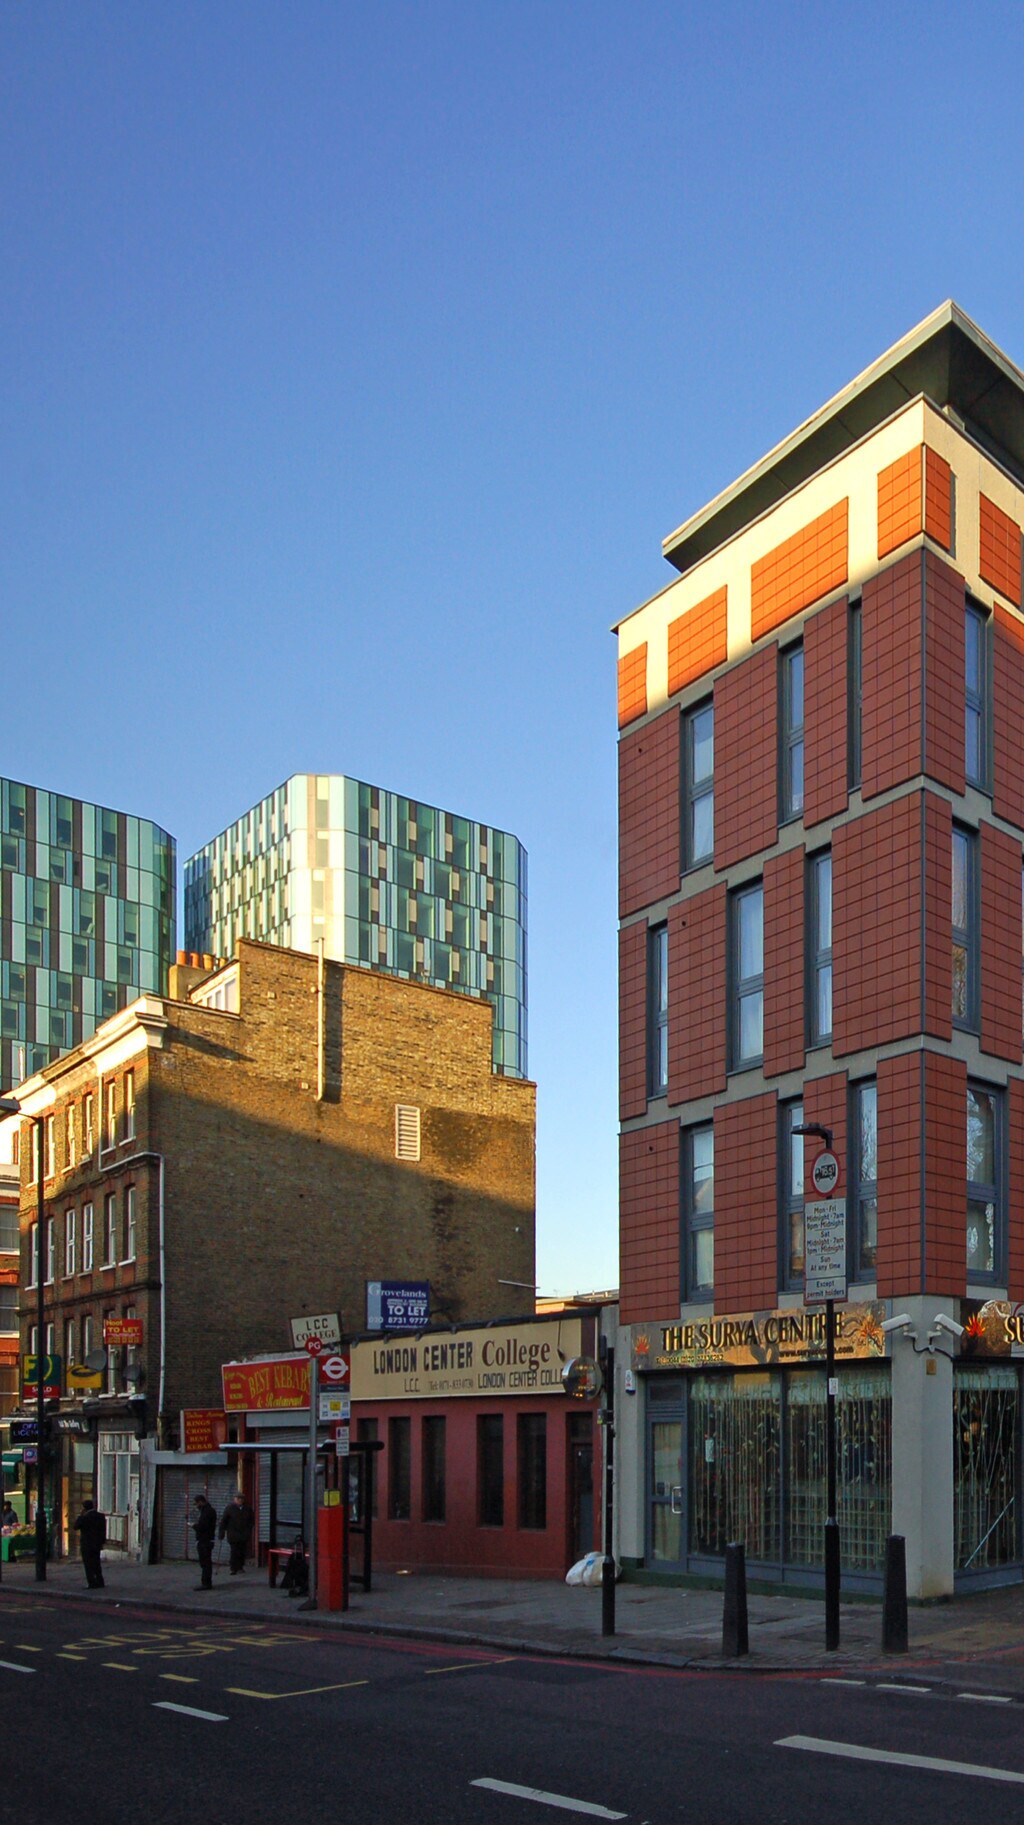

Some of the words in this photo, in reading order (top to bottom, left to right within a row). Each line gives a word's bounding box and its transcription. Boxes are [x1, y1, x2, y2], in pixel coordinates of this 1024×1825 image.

[813, 1206, 826, 1214] Mon
[829, 1204, 837, 1212] Fri
[806, 1212, 830, 1222] Midnight
[833, 1211, 845, 1219] 7am
[821, 1218, 844, 1229] Midnight
[806, 1238, 830, 1248] Midnight
[821, 1243, 844, 1253] Midnight
[821, 1255, 831, 1263] Sun
[810, 1264, 817, 1272] At
[829, 1262, 841, 1270] time
[816, 1280, 835, 1288] Except
[368, 1283, 427, 1298] Grovelands
[806, 1289, 824, 1299] permit
[824, 1288, 845, 1297] holders
[388, 1305, 405, 1316] TO
[408, 1306, 426, 1317] LET
[660, 1326, 694, 1350] THE
[698, 1319, 760, 1350] SURYA
[764, 1312, 844, 1344] CENTRE
[308, 1342, 321, 1351] PG
[373, 1348, 418, 1375] LONDON
[423, 1341, 474, 1370] CENTER
[481, 1338, 551, 1373] College
[248, 1367, 270, 1399] BEST
[478, 1372, 506, 1390] LONDON
[509, 1370, 537, 1389] CENTER
